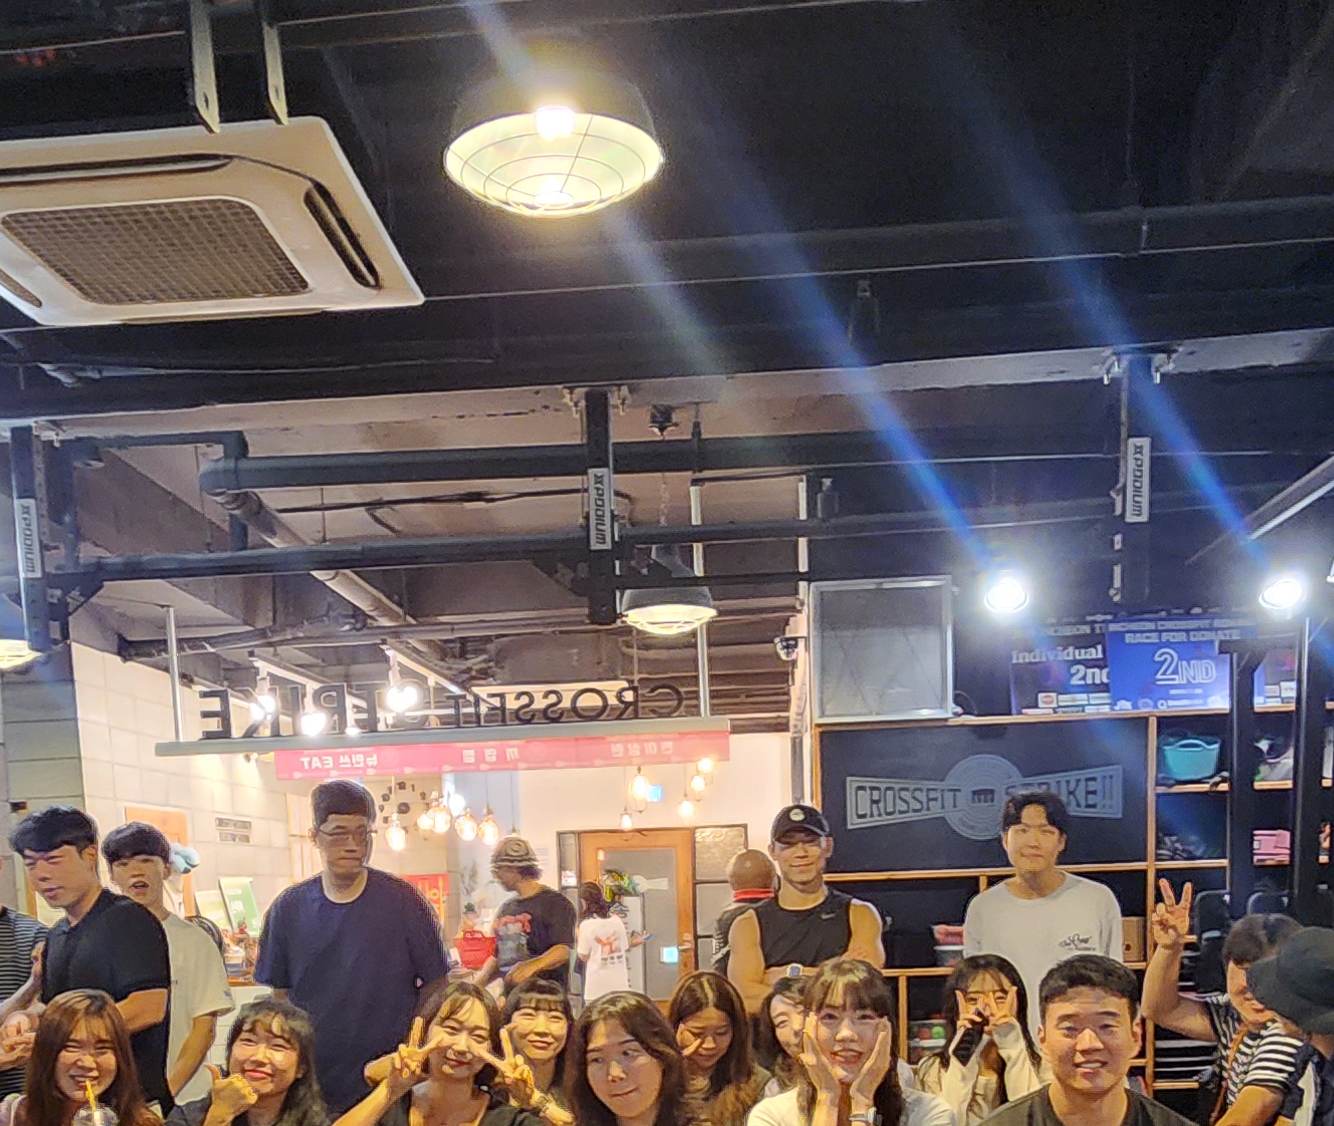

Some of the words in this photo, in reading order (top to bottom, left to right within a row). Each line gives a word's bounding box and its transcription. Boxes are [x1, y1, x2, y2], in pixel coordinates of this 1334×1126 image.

[1011, 643, 1104, 664] Individual
[1153, 648, 1217, 685] 2ND
[853, 784, 962, 820] CROSSFIT
